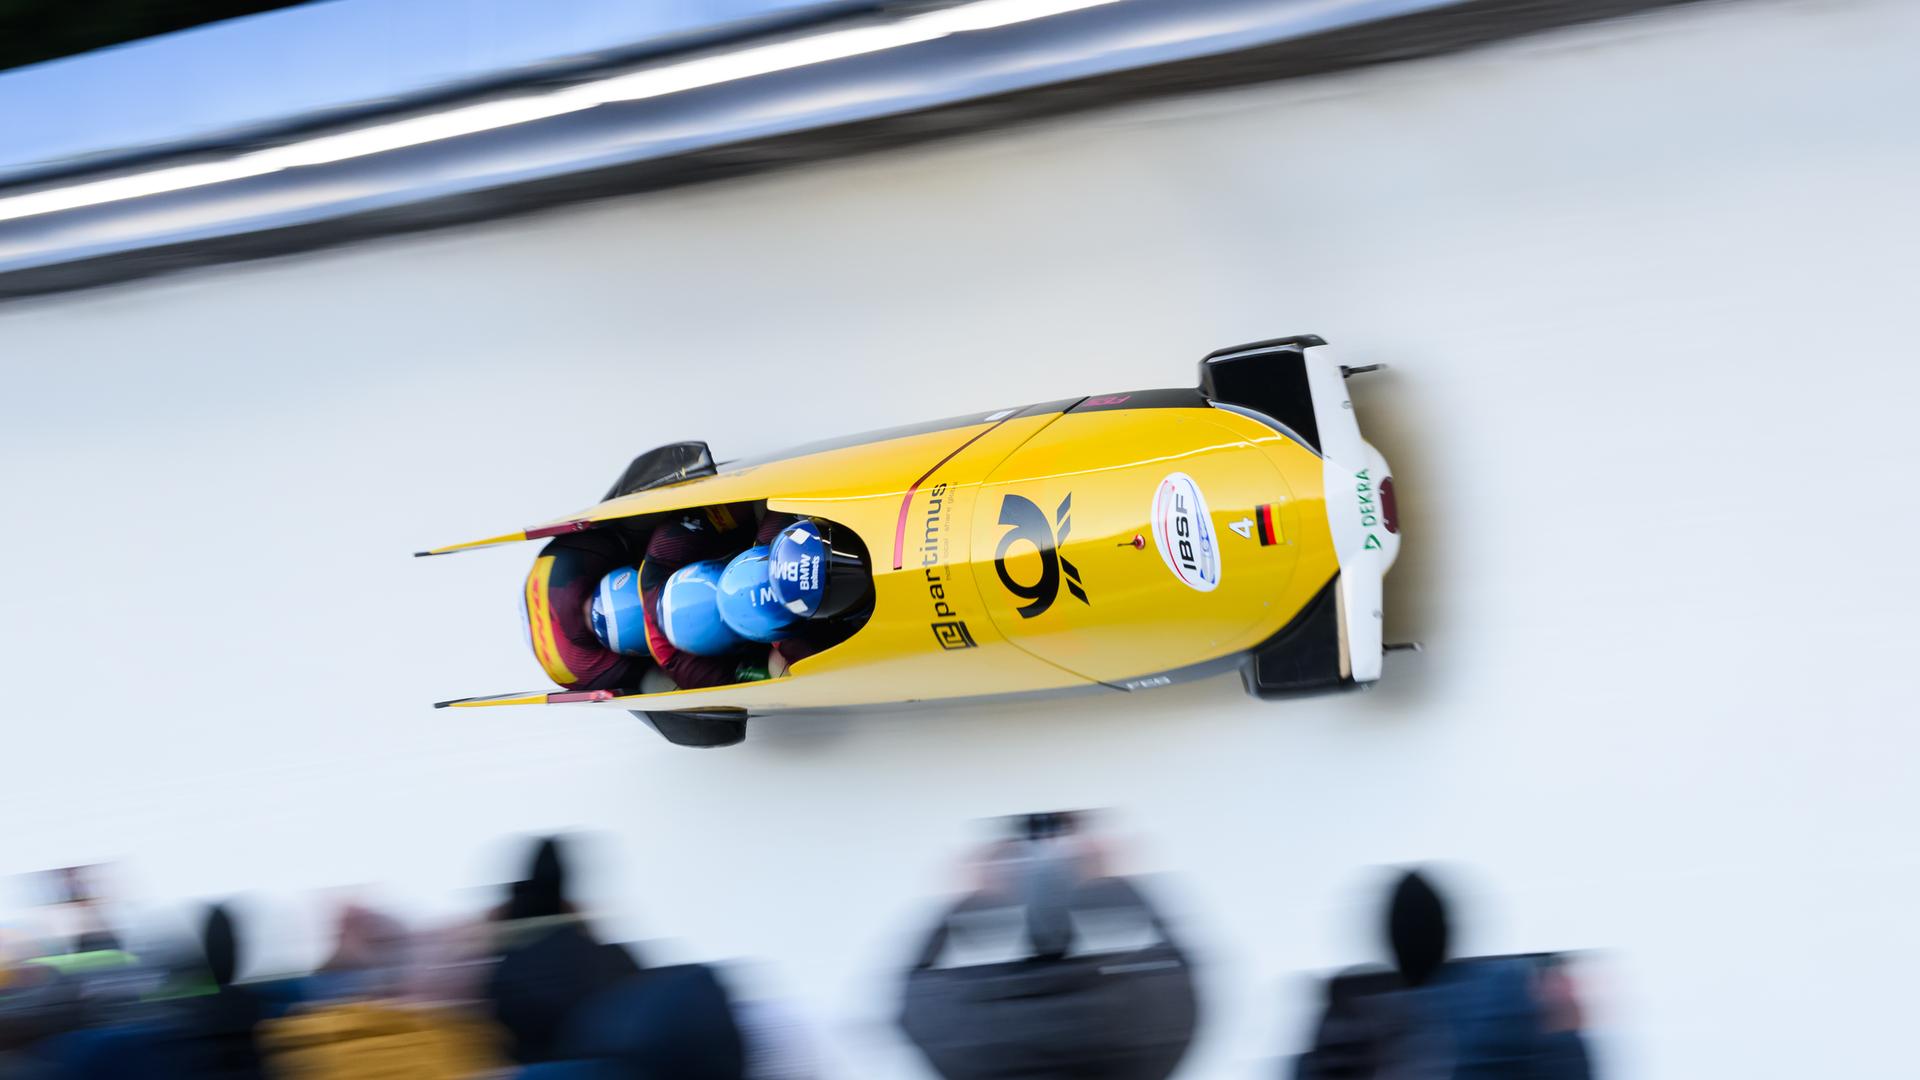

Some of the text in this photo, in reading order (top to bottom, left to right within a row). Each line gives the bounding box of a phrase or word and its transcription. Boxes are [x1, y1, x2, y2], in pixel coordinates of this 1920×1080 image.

[1355, 469, 1377, 527] DEKRA
[920, 483, 956, 617] partimus
[1176, 493, 1197, 571] IBSF
[1228, 517, 1254, 539] 4
[800, 554, 811, 591] BMW
